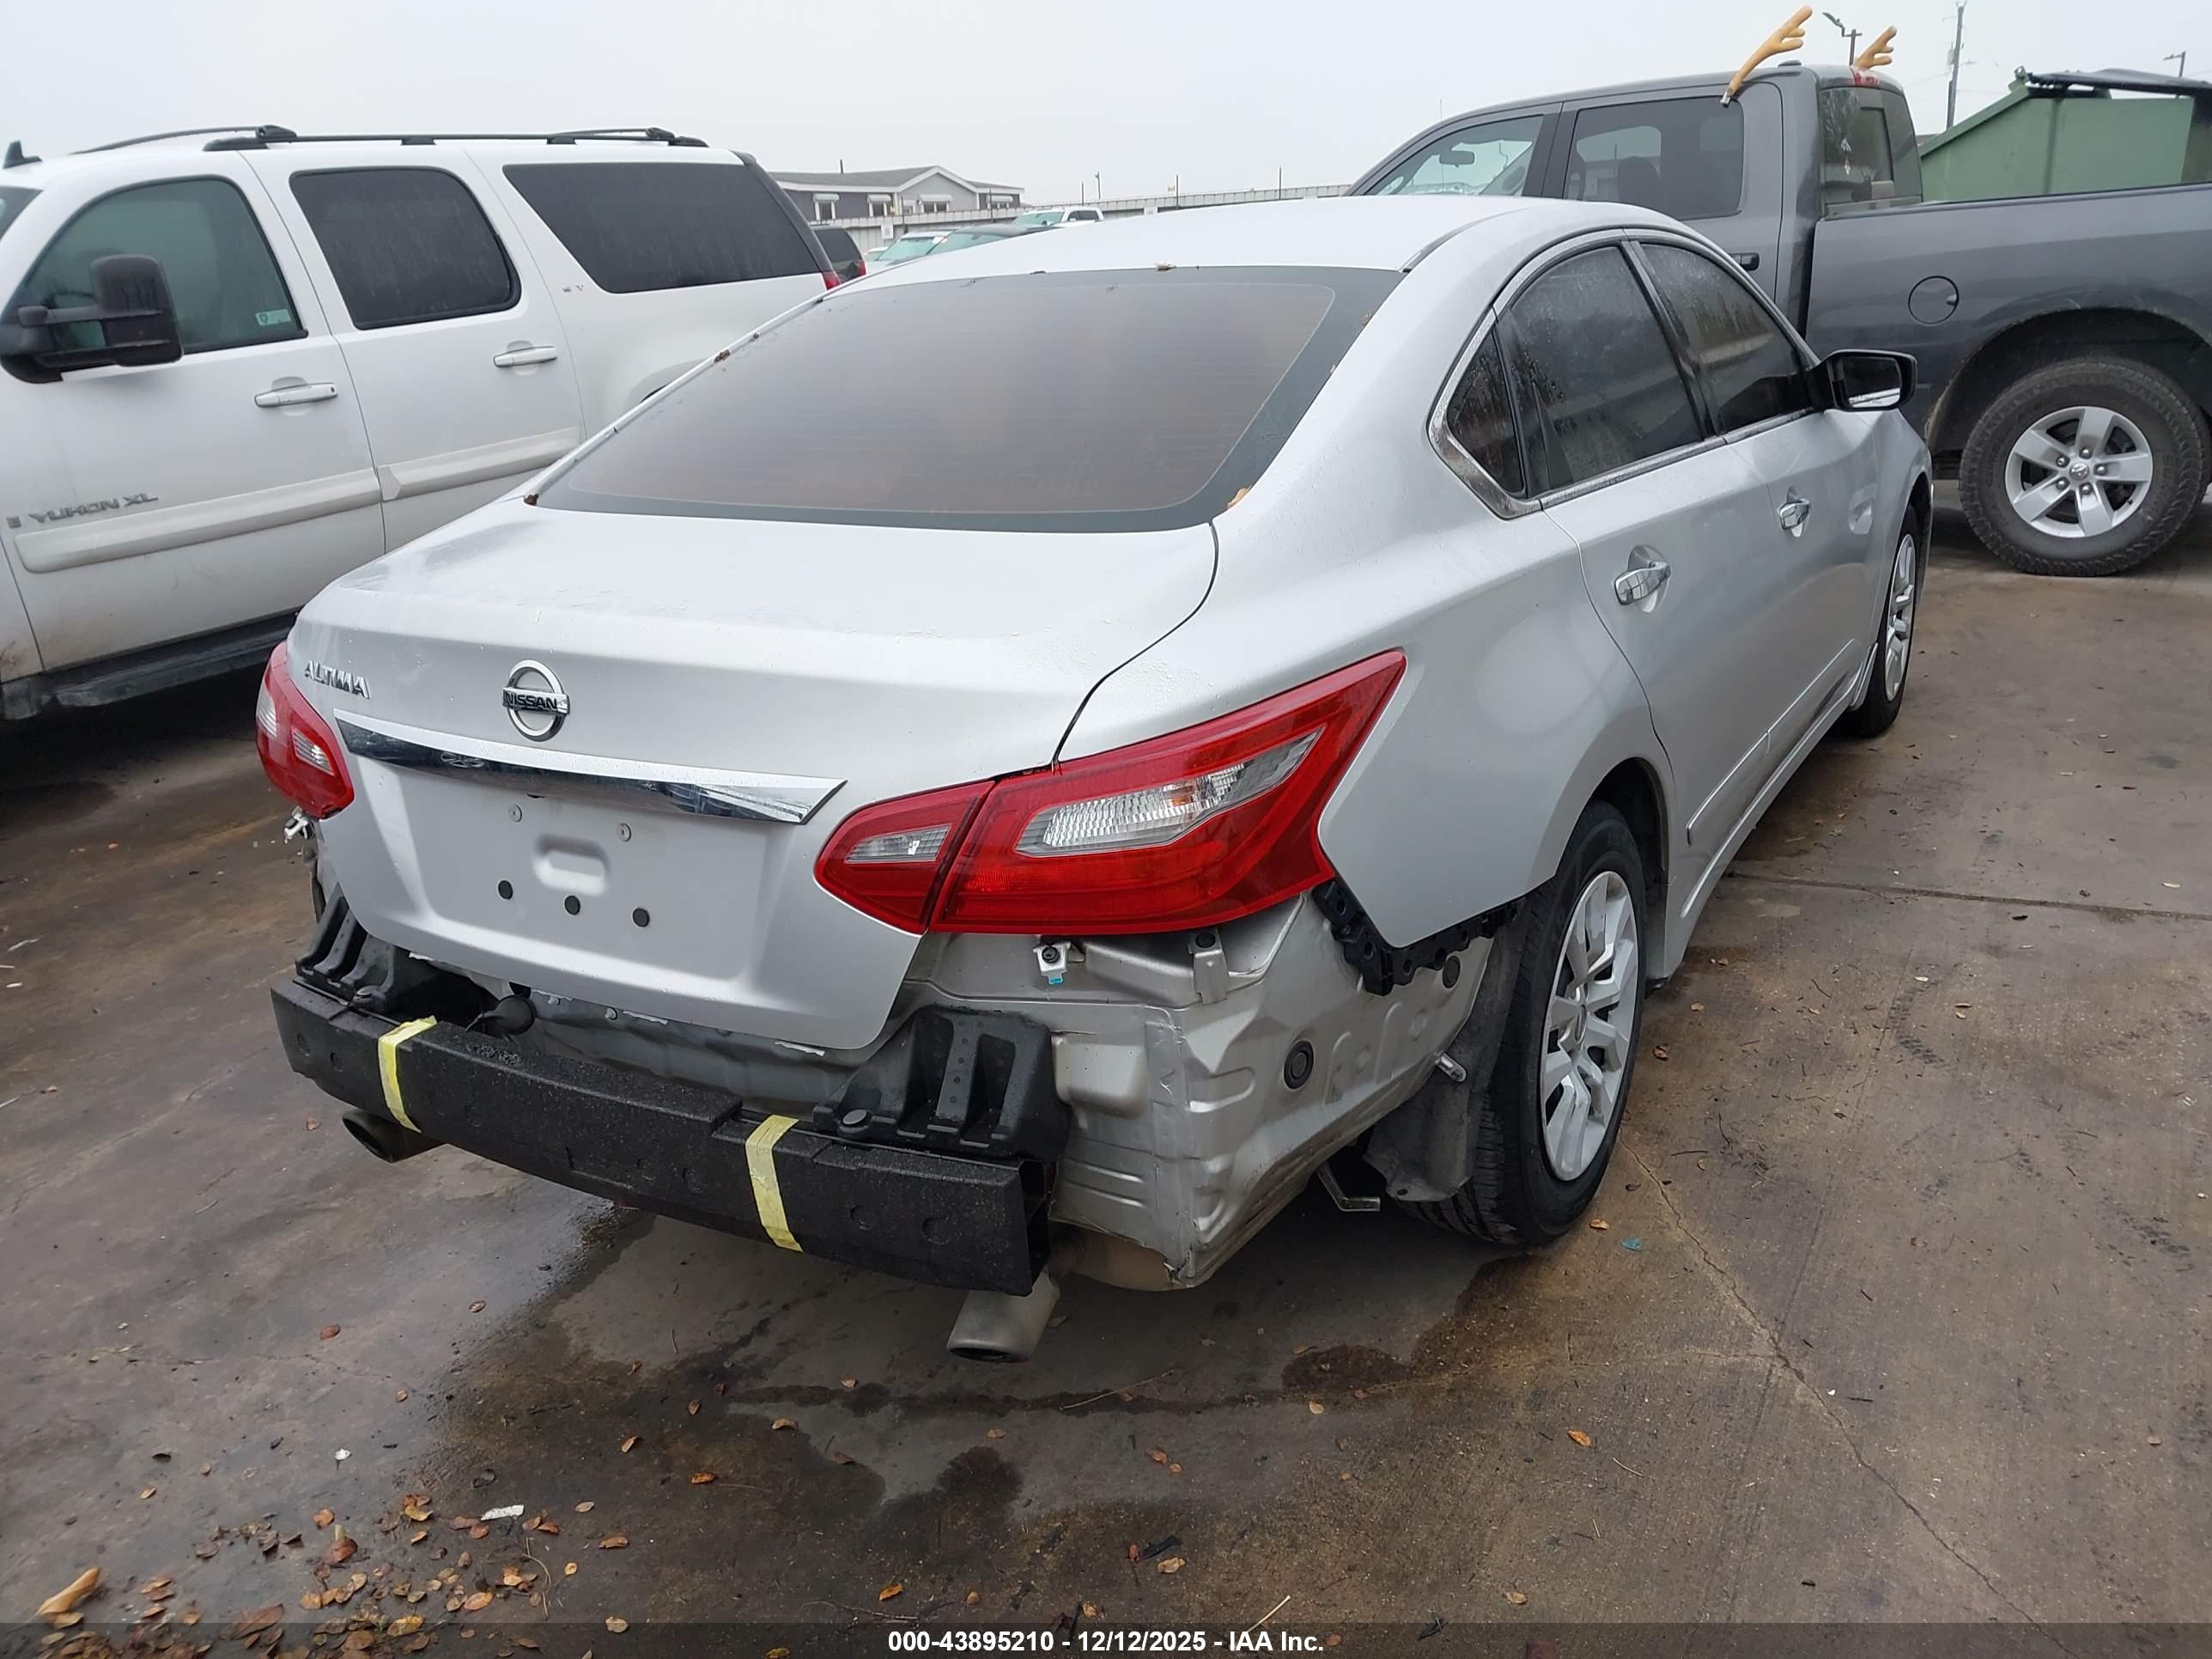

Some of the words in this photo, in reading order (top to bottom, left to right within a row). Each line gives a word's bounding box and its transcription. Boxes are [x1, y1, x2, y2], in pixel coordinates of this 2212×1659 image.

[28, 498, 120, 523] YUKON
[123, 492, 159, 507] XL
[303, 659, 370, 700] ALTIMA
[503, 690, 558, 711] NISSAN
